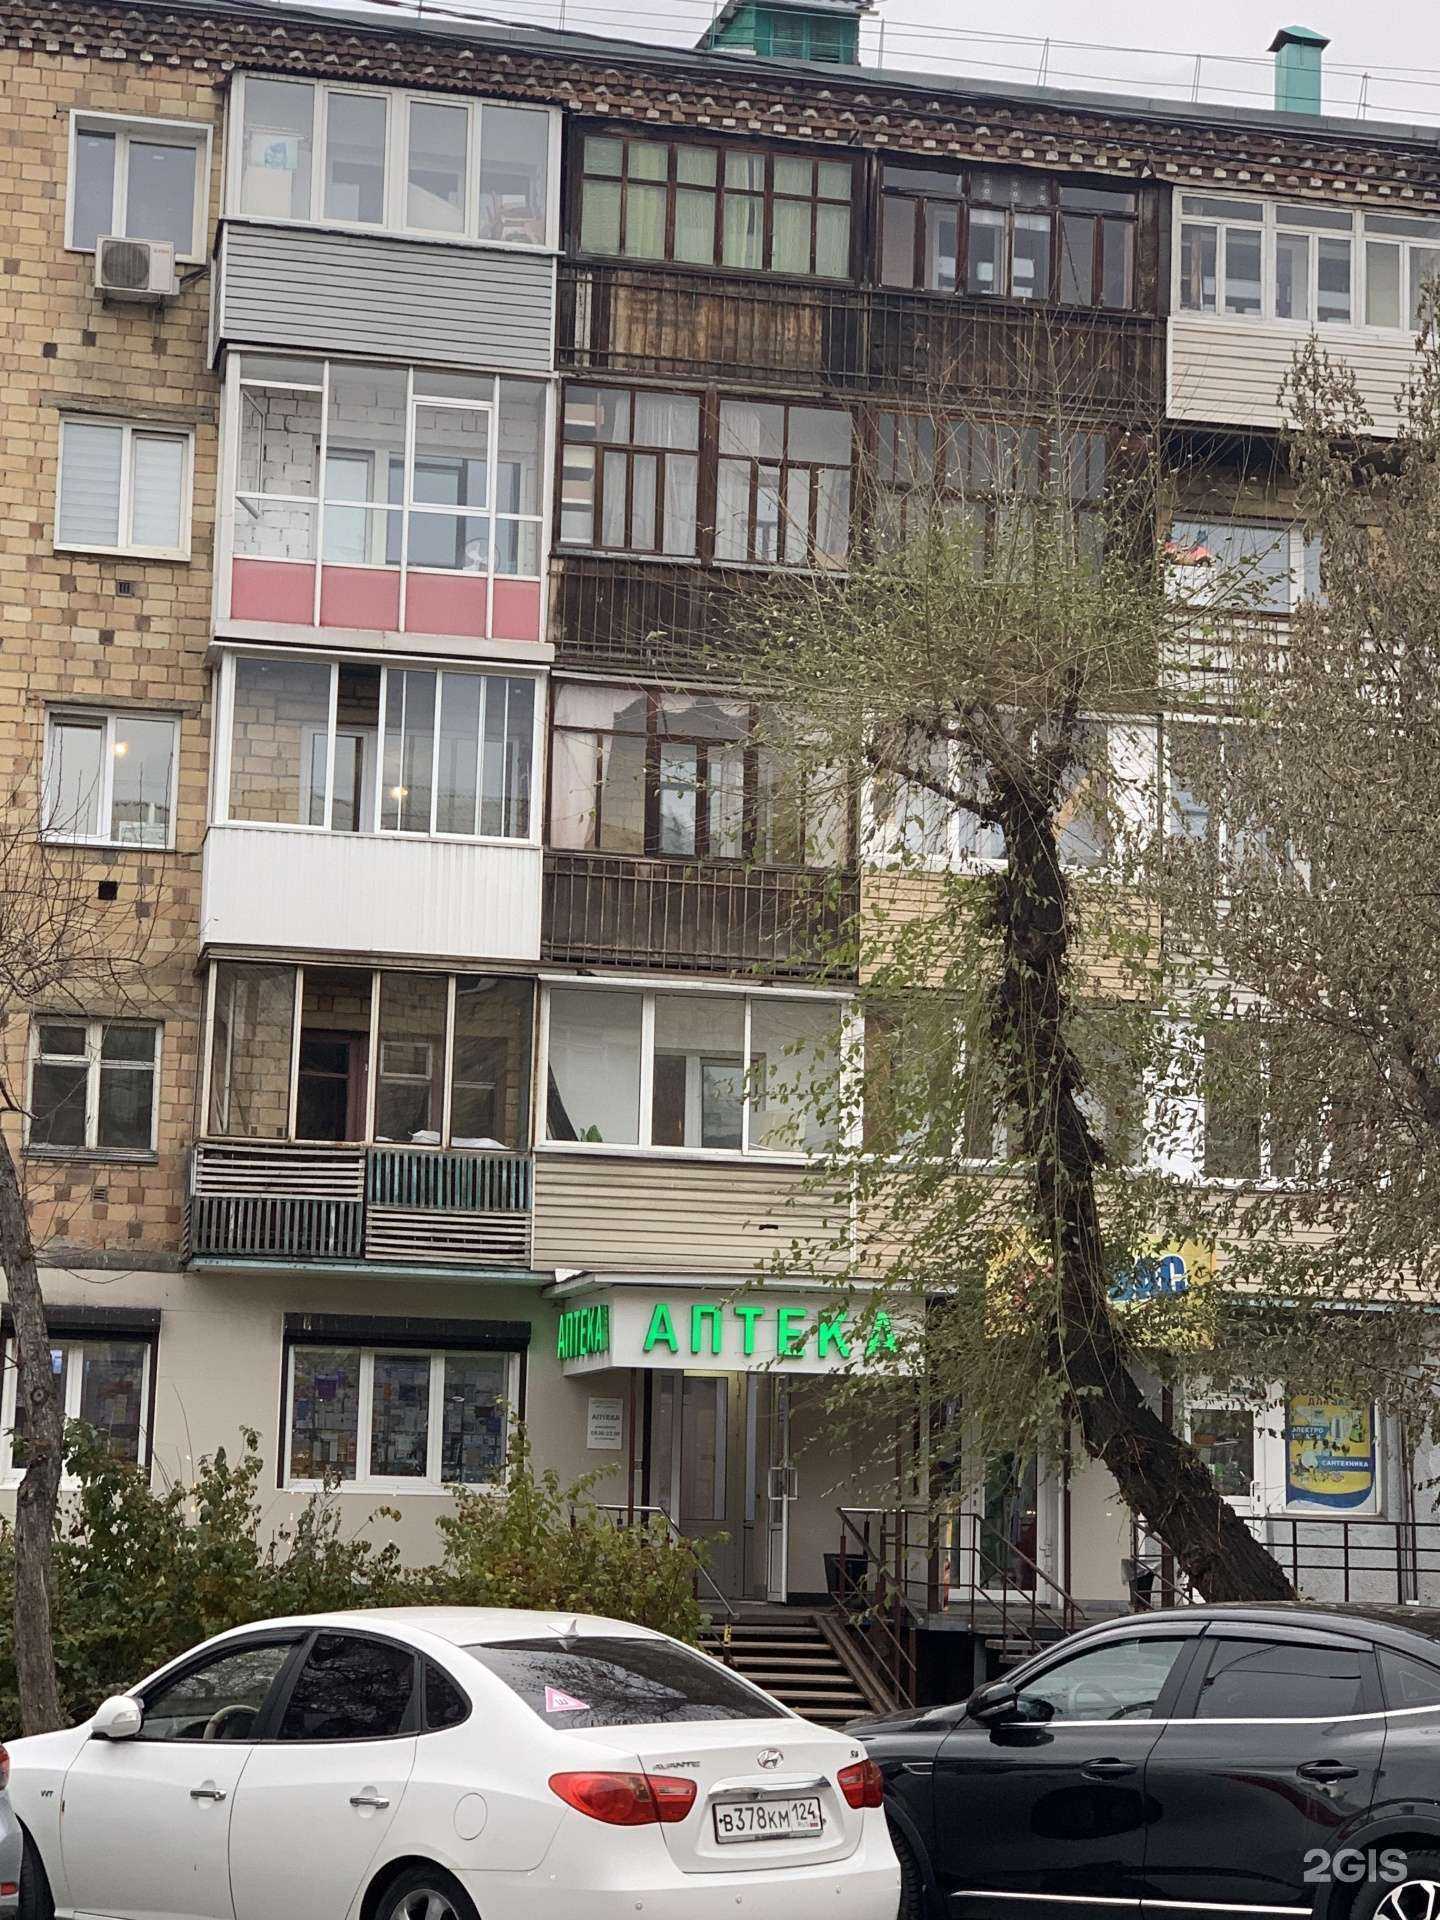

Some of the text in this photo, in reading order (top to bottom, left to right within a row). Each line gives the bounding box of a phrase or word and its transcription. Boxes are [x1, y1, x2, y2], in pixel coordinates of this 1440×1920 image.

[557, 1305, 603, 1359] АПТЕКА
[643, 1303, 898, 1358] АПТЕКА
[1321, 1460, 1369, 1468] САНТЕХНИКА
[792, 1802, 817, 1820] 124
